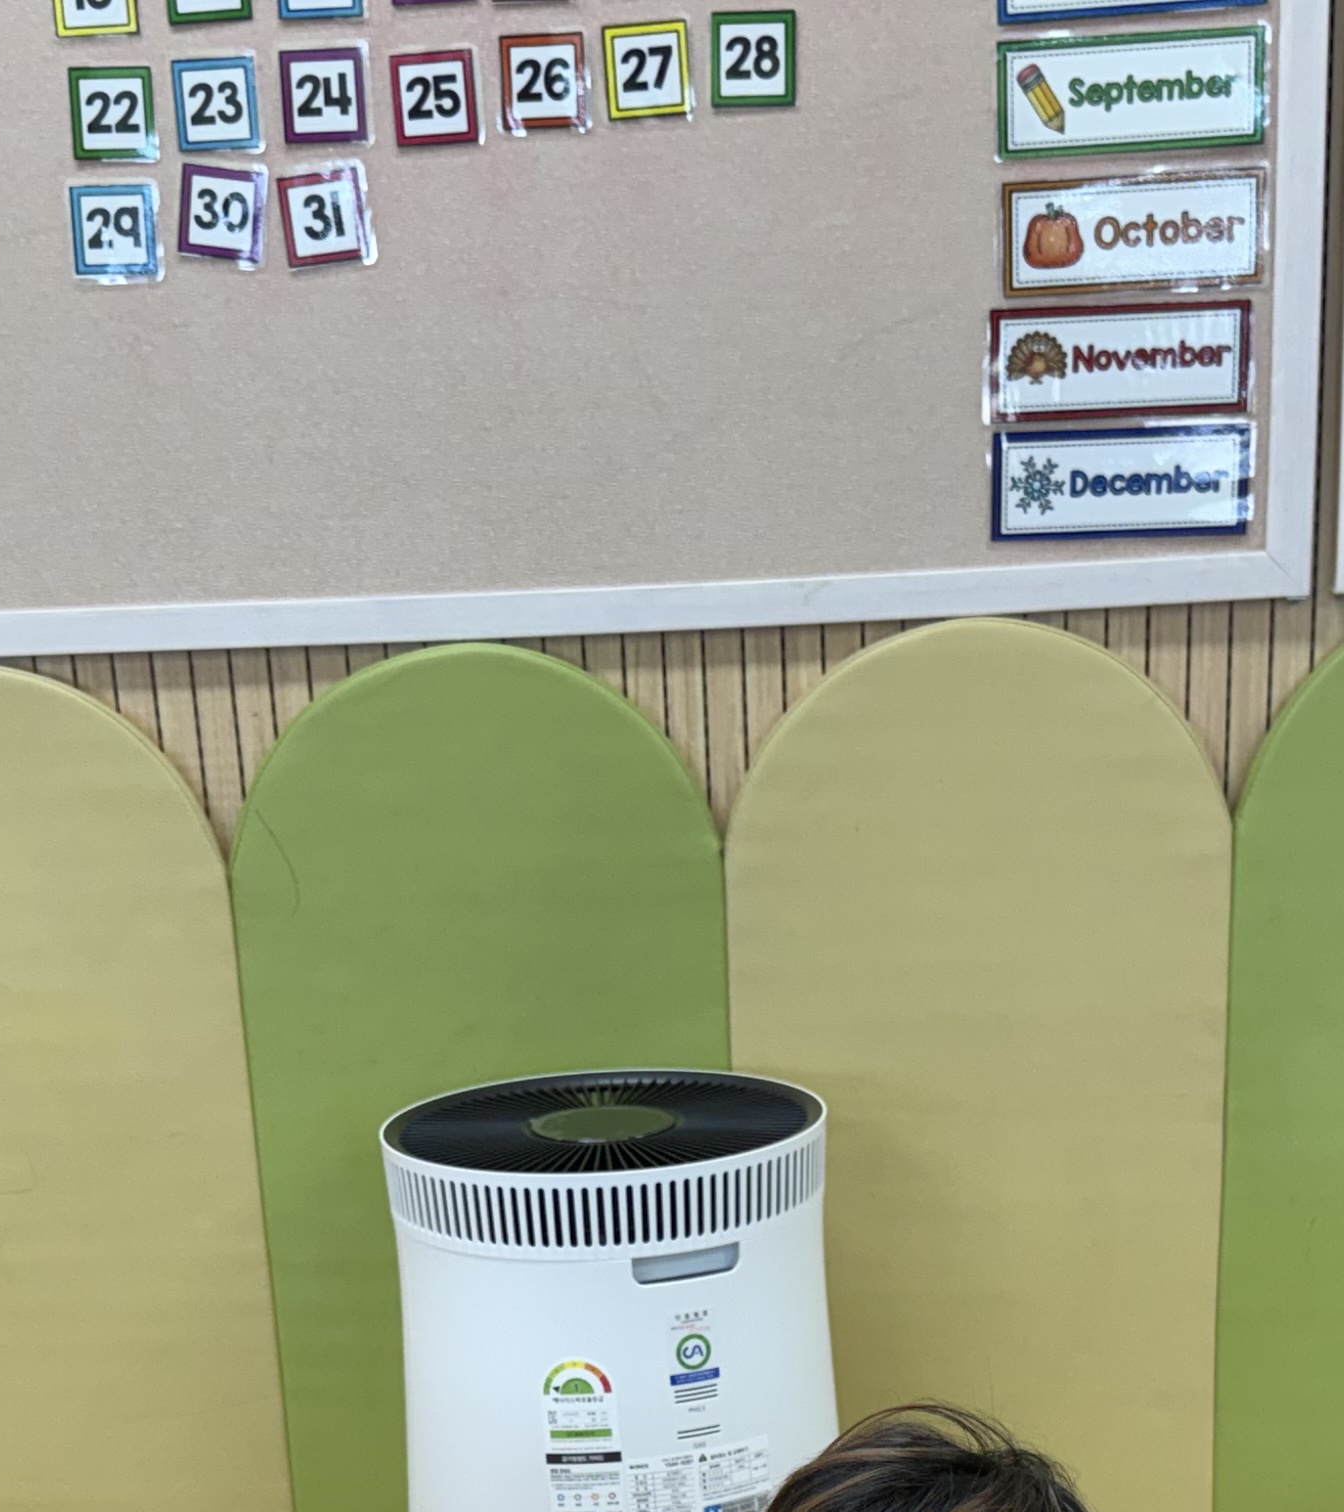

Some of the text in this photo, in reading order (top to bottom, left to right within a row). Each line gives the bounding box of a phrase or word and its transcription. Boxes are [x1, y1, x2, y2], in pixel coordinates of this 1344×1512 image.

[621, 45, 672, 91] 27
[725, 35, 780, 80] 28
[296, 73, 352, 116] 24
[405, 74, 461, 120] 25
[515, 58, 570, 102] 26
[1068, 71, 1238, 111] September
[85, 91, 140, 134] 22
[189, 82, 243, 126] 23
[87, 208, 141, 249] 29
[193, 189, 249, 232] 30
[304, 191, 345, 241] 31
[1094, 211, 1244, 249] October
[1072, 340, 1230, 374] November
[1069, 465, 1227, 497] December
